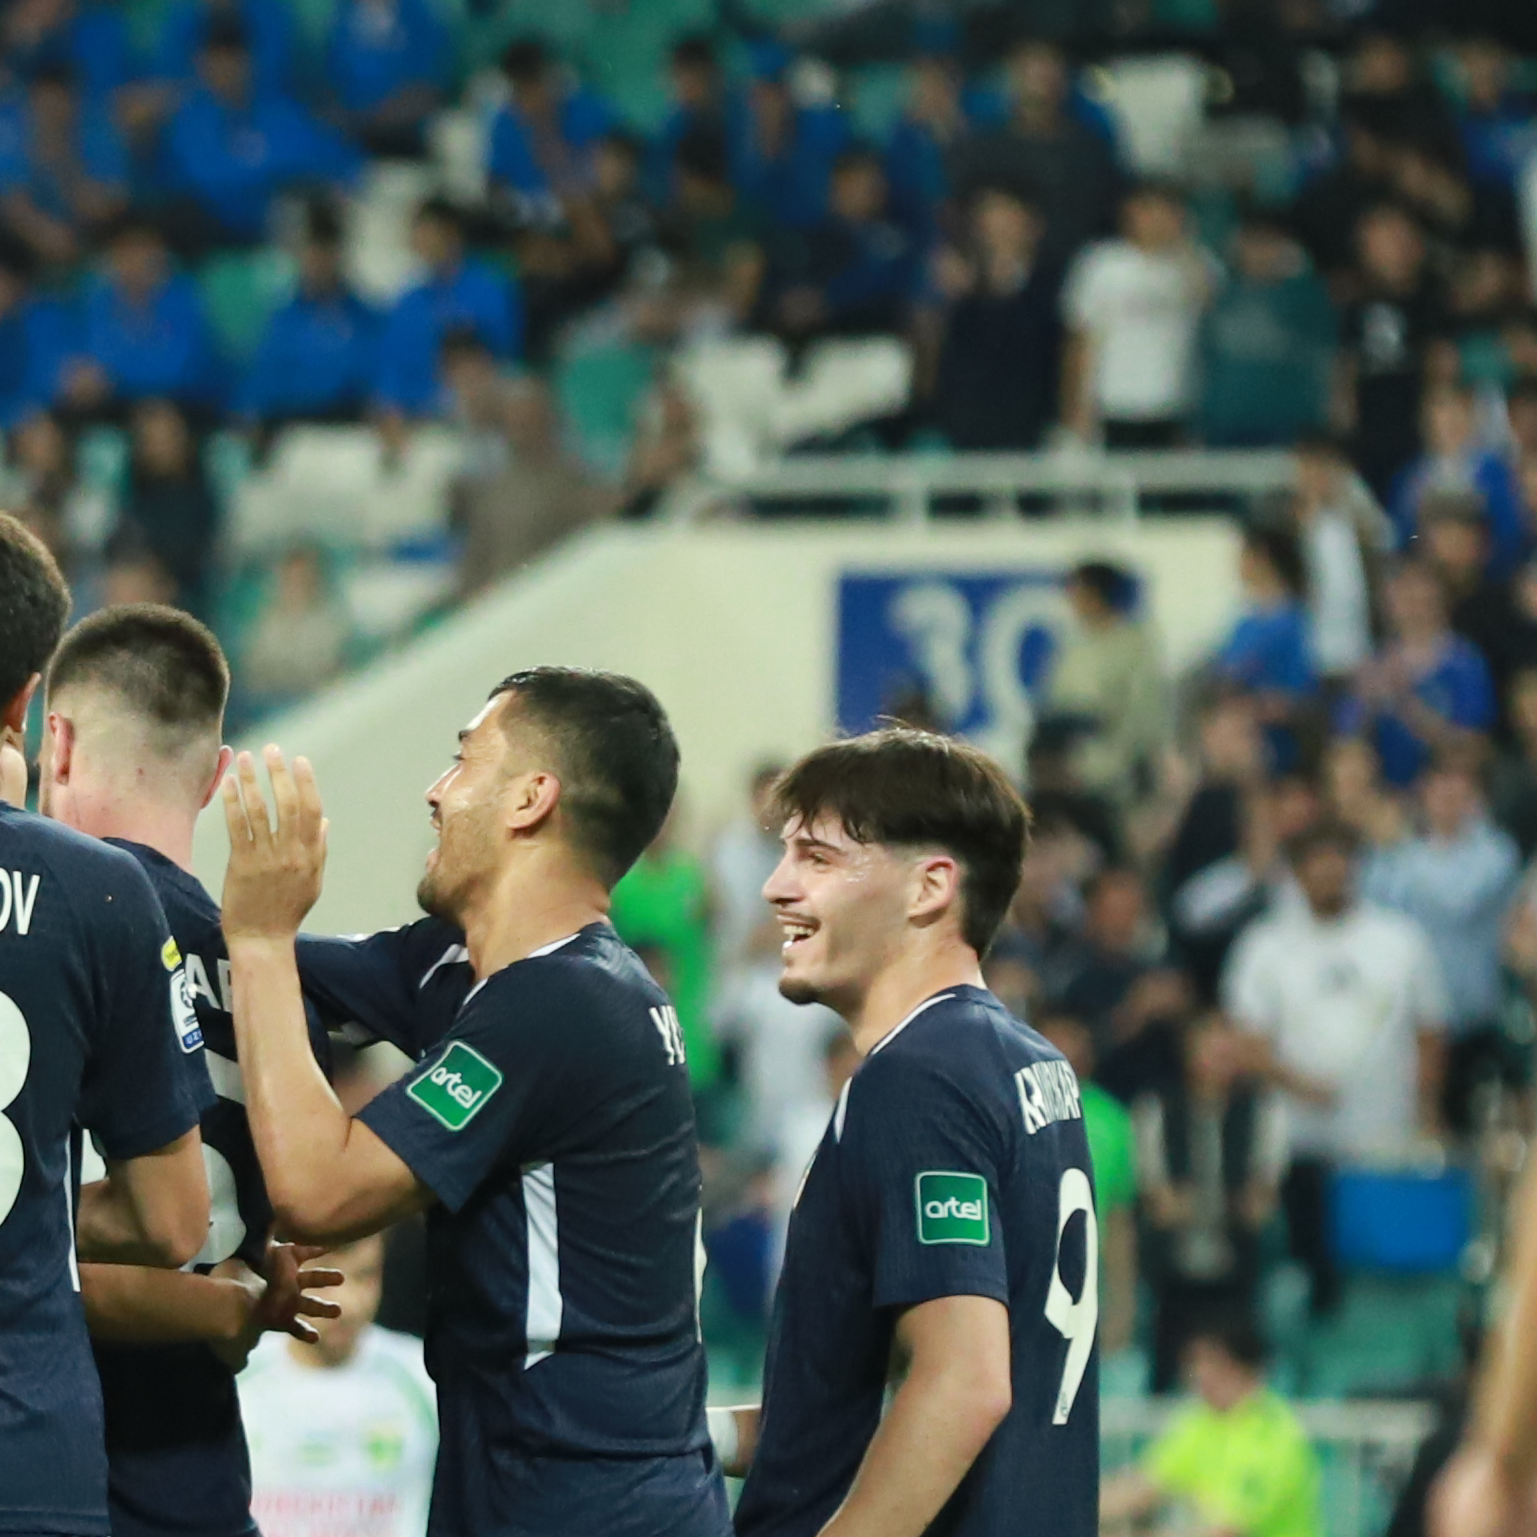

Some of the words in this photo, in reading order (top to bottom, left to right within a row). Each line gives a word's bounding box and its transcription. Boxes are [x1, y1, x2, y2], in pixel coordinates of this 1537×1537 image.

[430, 1066, 483, 1109] artel
[924, 1196, 983, 1221] artel
[1044, 1168, 1099, 1426] 9
